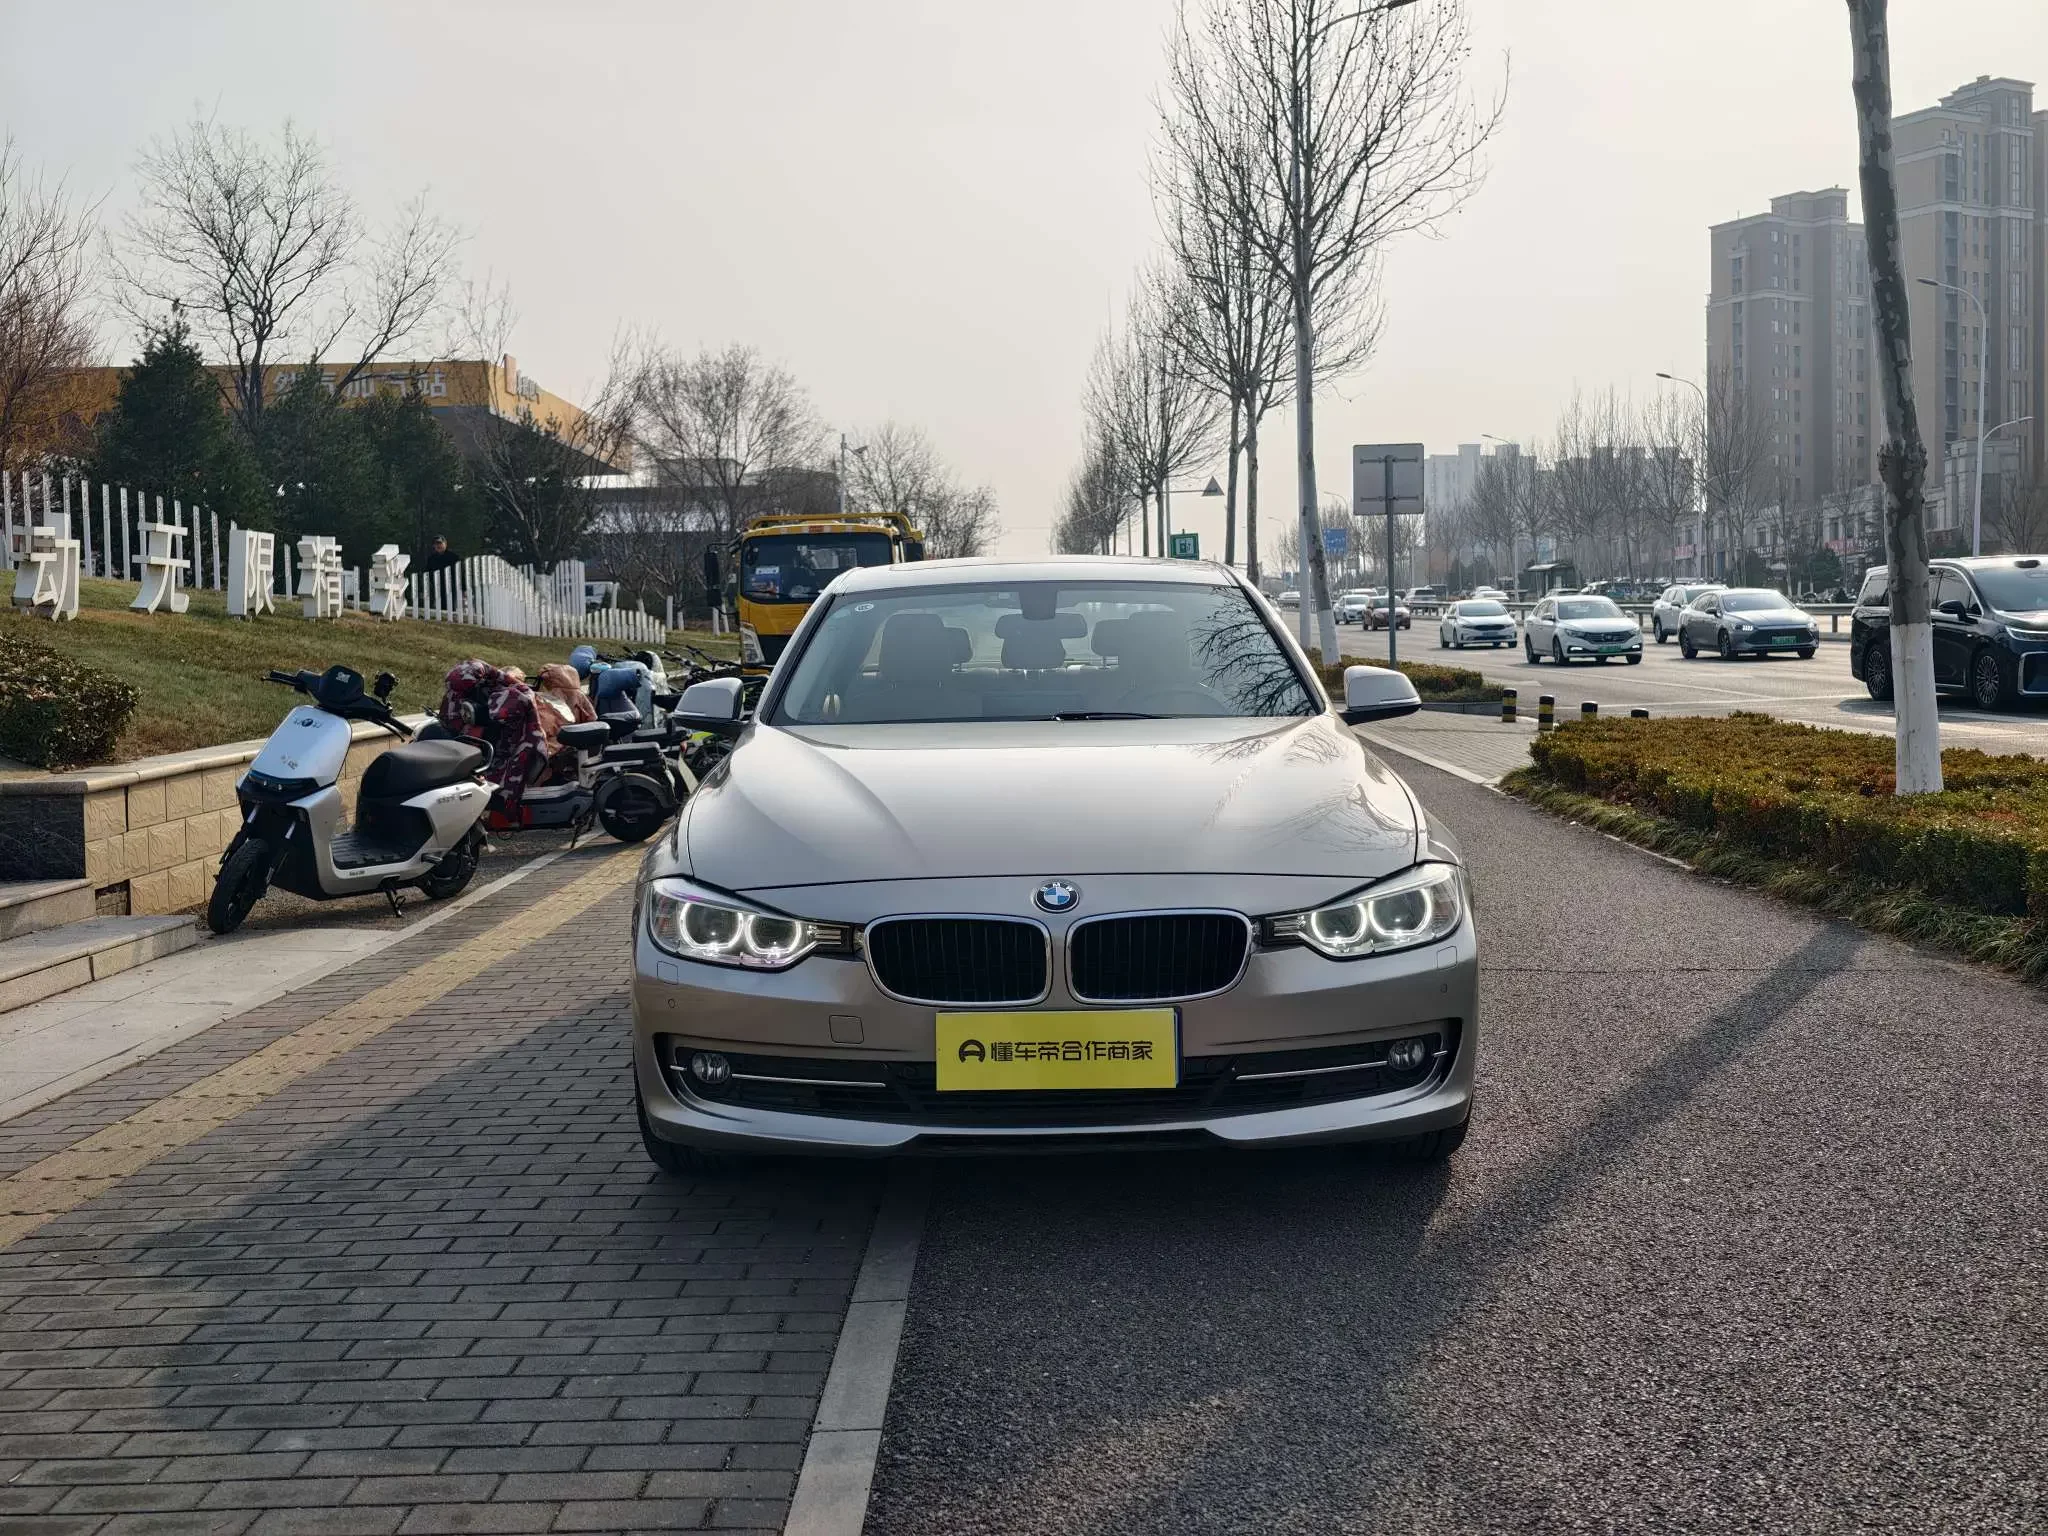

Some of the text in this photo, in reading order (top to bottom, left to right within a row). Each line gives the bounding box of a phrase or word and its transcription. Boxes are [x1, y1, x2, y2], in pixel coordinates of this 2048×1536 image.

[990, 1040, 1153, 1062] 懂车帝合作商家
